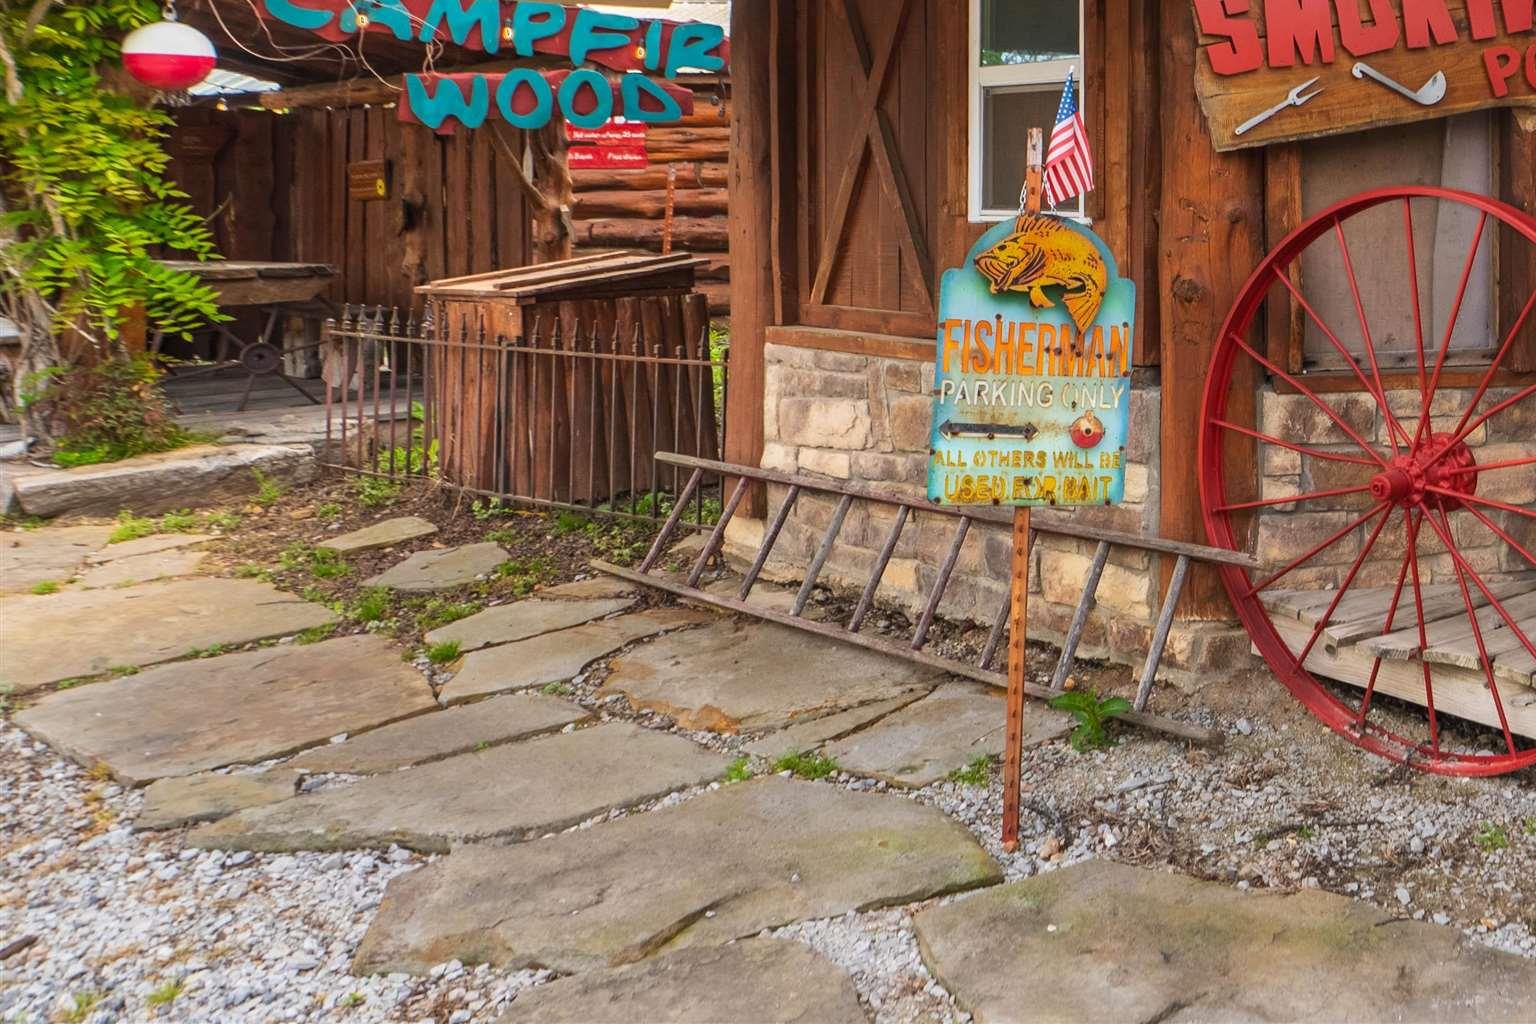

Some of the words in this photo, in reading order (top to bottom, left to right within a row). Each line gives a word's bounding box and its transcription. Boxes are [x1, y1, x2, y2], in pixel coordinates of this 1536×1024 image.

[407, 68, 681, 129] WOOD
[942, 318, 1129, 378] FISHERMAN
[940, 379, 1053, 408] PARKING
[1061, 382, 1124, 410] ONLY
[933, 450, 967, 468] ALL
[973, 449, 1048, 469] OTHERS
[1052, 450, 1093, 469] WILL
[1099, 451, 1122, 469] BE
[944, 474, 1006, 502] USED
[1012, 475, 1058, 501] FOR
[1062, 475, 1113, 502] BAIT
